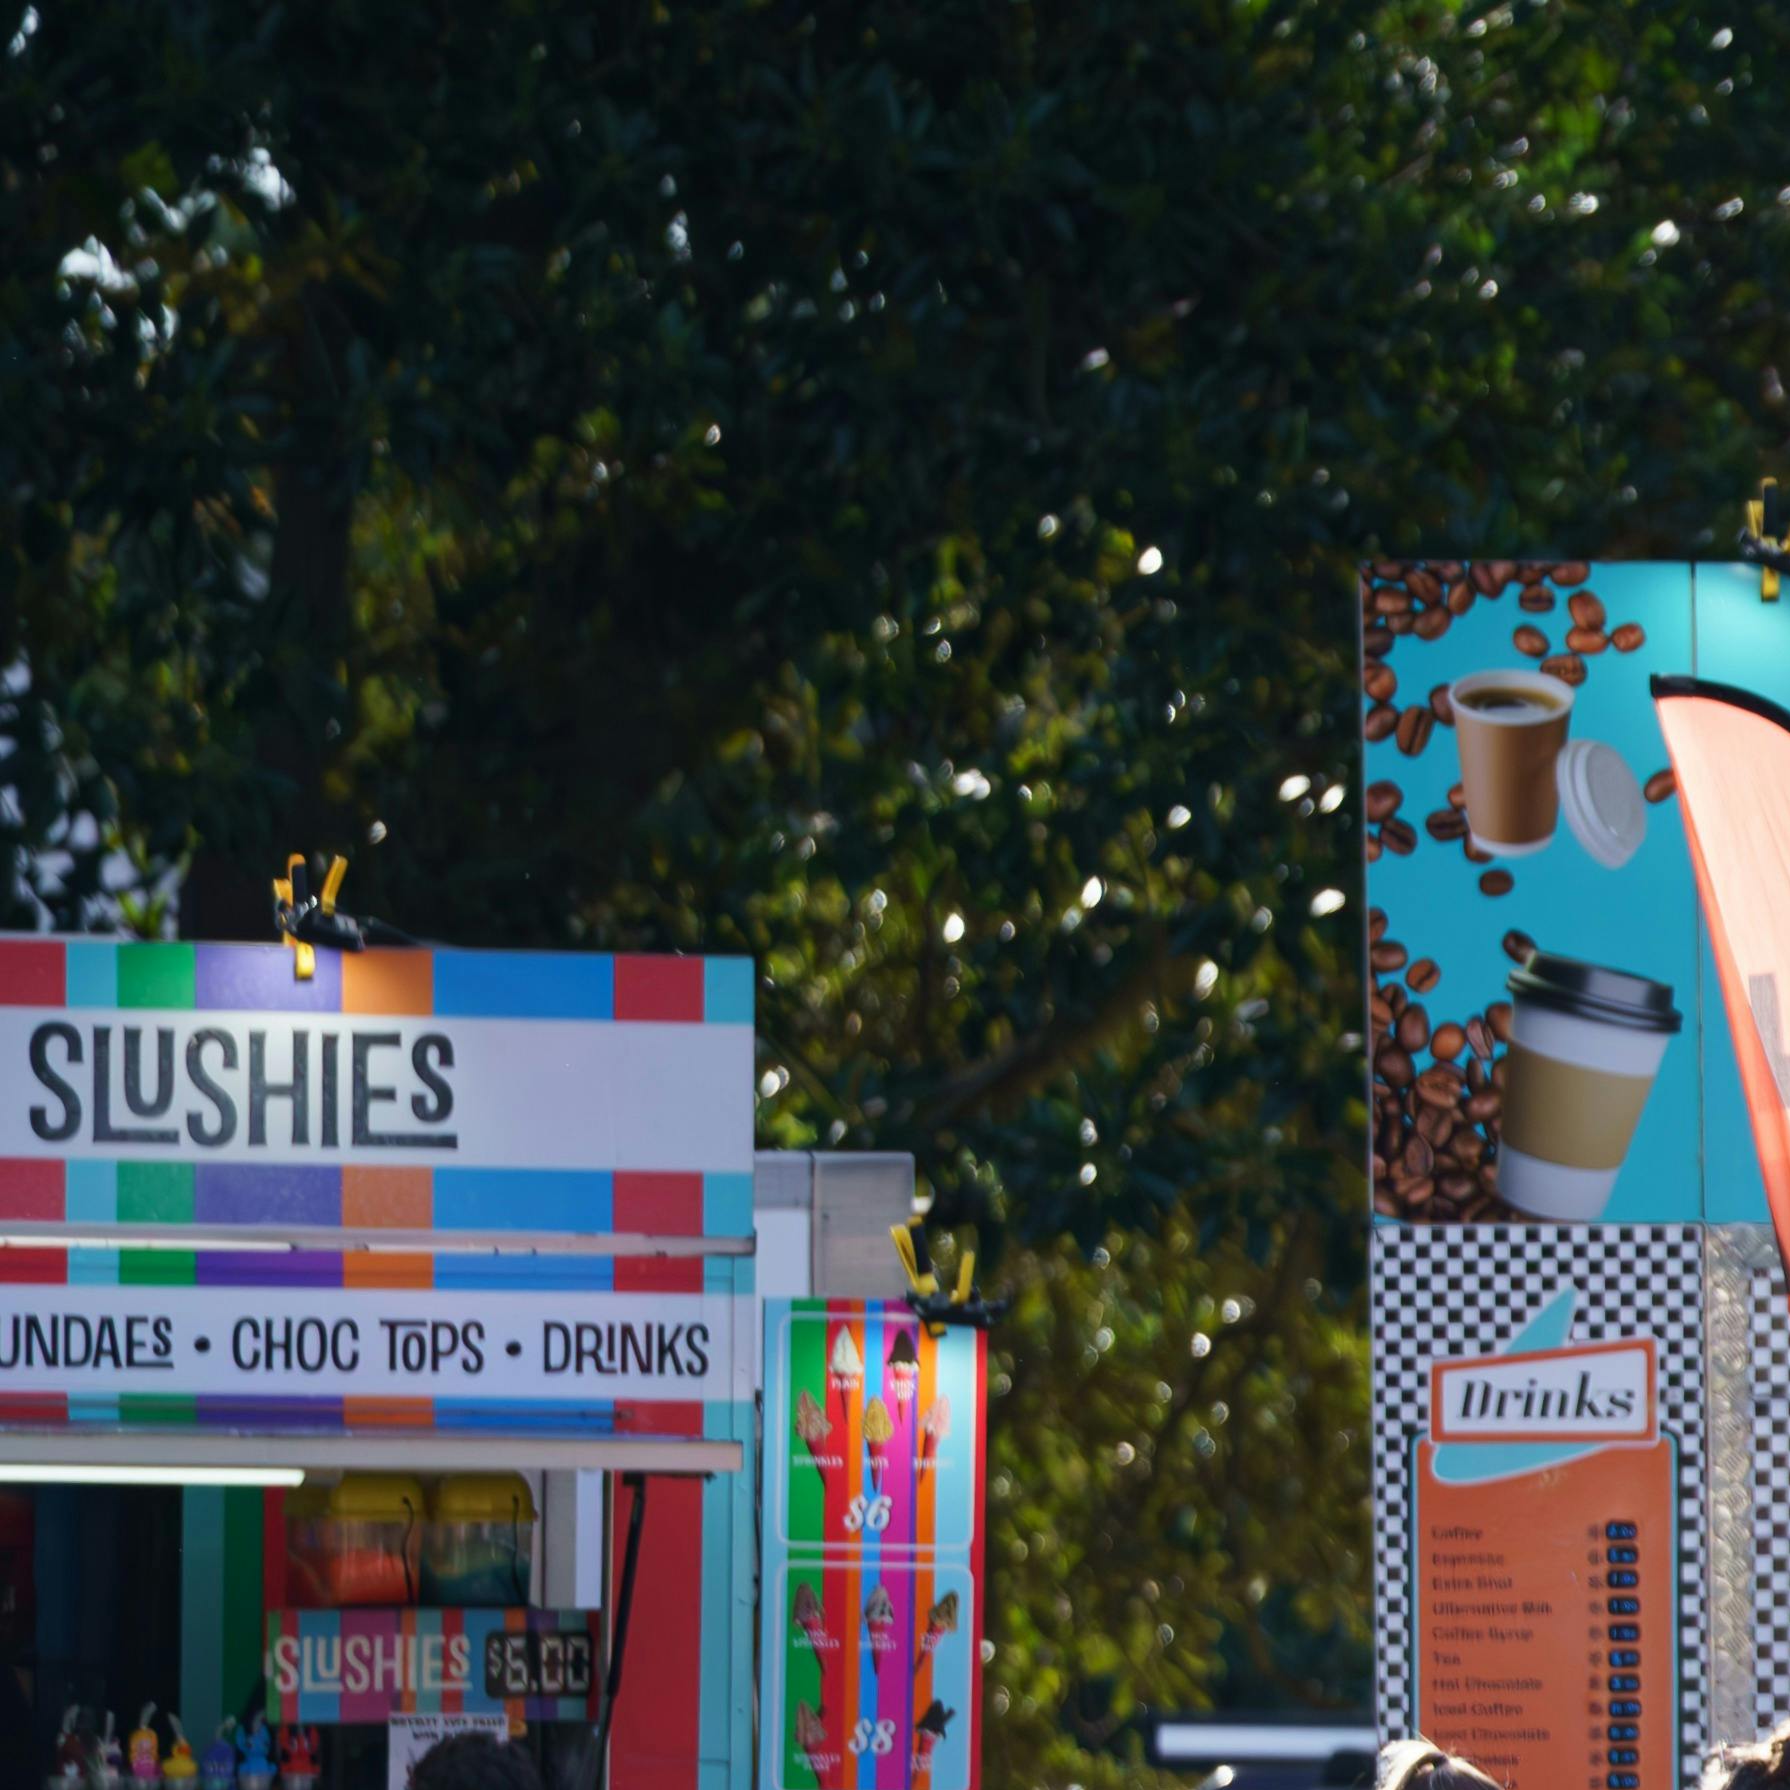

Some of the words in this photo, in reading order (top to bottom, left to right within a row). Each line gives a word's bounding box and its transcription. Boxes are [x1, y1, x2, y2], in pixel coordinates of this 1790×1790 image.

[28, 1020, 458, 1151] SLUSHIES
[231, 1316, 360, 1372] CHOC
[379, 1319, 486, 1375] TOPS
[542, 1322, 711, 1377] DRINKS
[1460, 1371, 1635, 1419] Drinks
[843, 1494, 893, 1532] $6
[274, 1634, 473, 1693] SLUSHIES
[848, 1718, 897, 1756] $8
